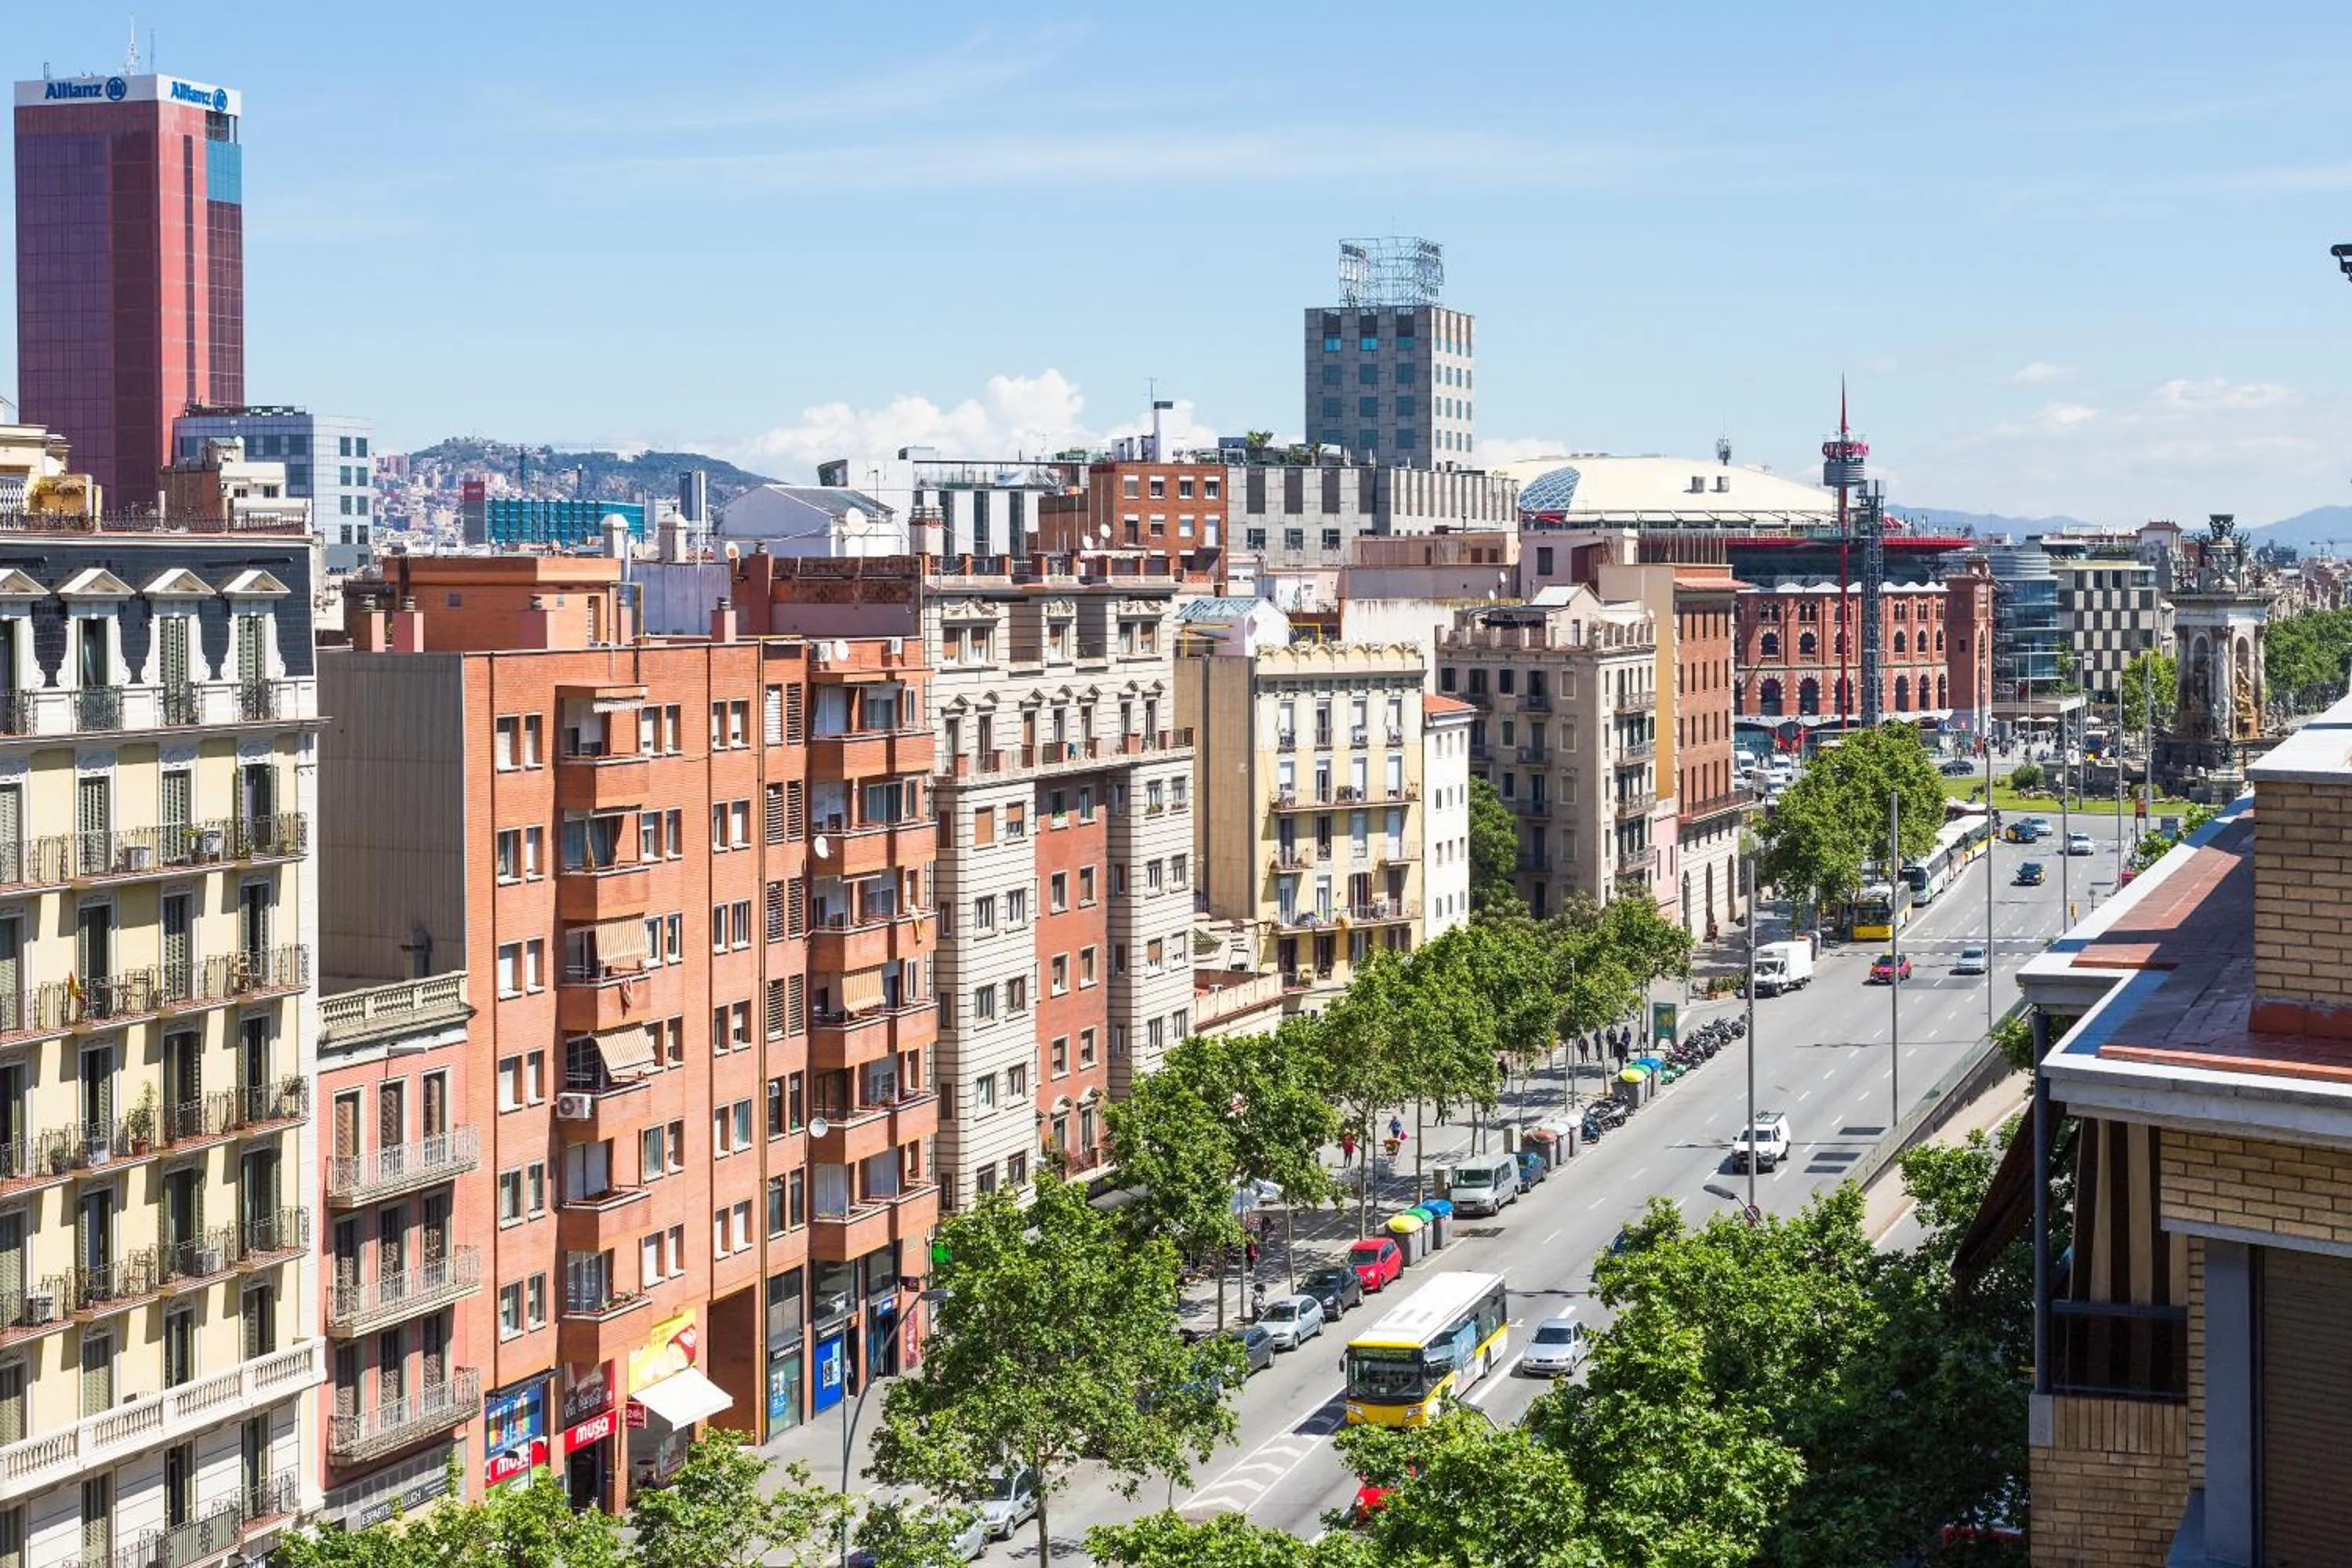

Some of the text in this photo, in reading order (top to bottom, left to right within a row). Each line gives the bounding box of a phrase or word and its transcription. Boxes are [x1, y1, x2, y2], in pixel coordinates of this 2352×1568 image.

[45, 82, 103, 100] Allianz
[170, 81, 212, 106] Allianz
[575, 1416, 610, 1443] musa
